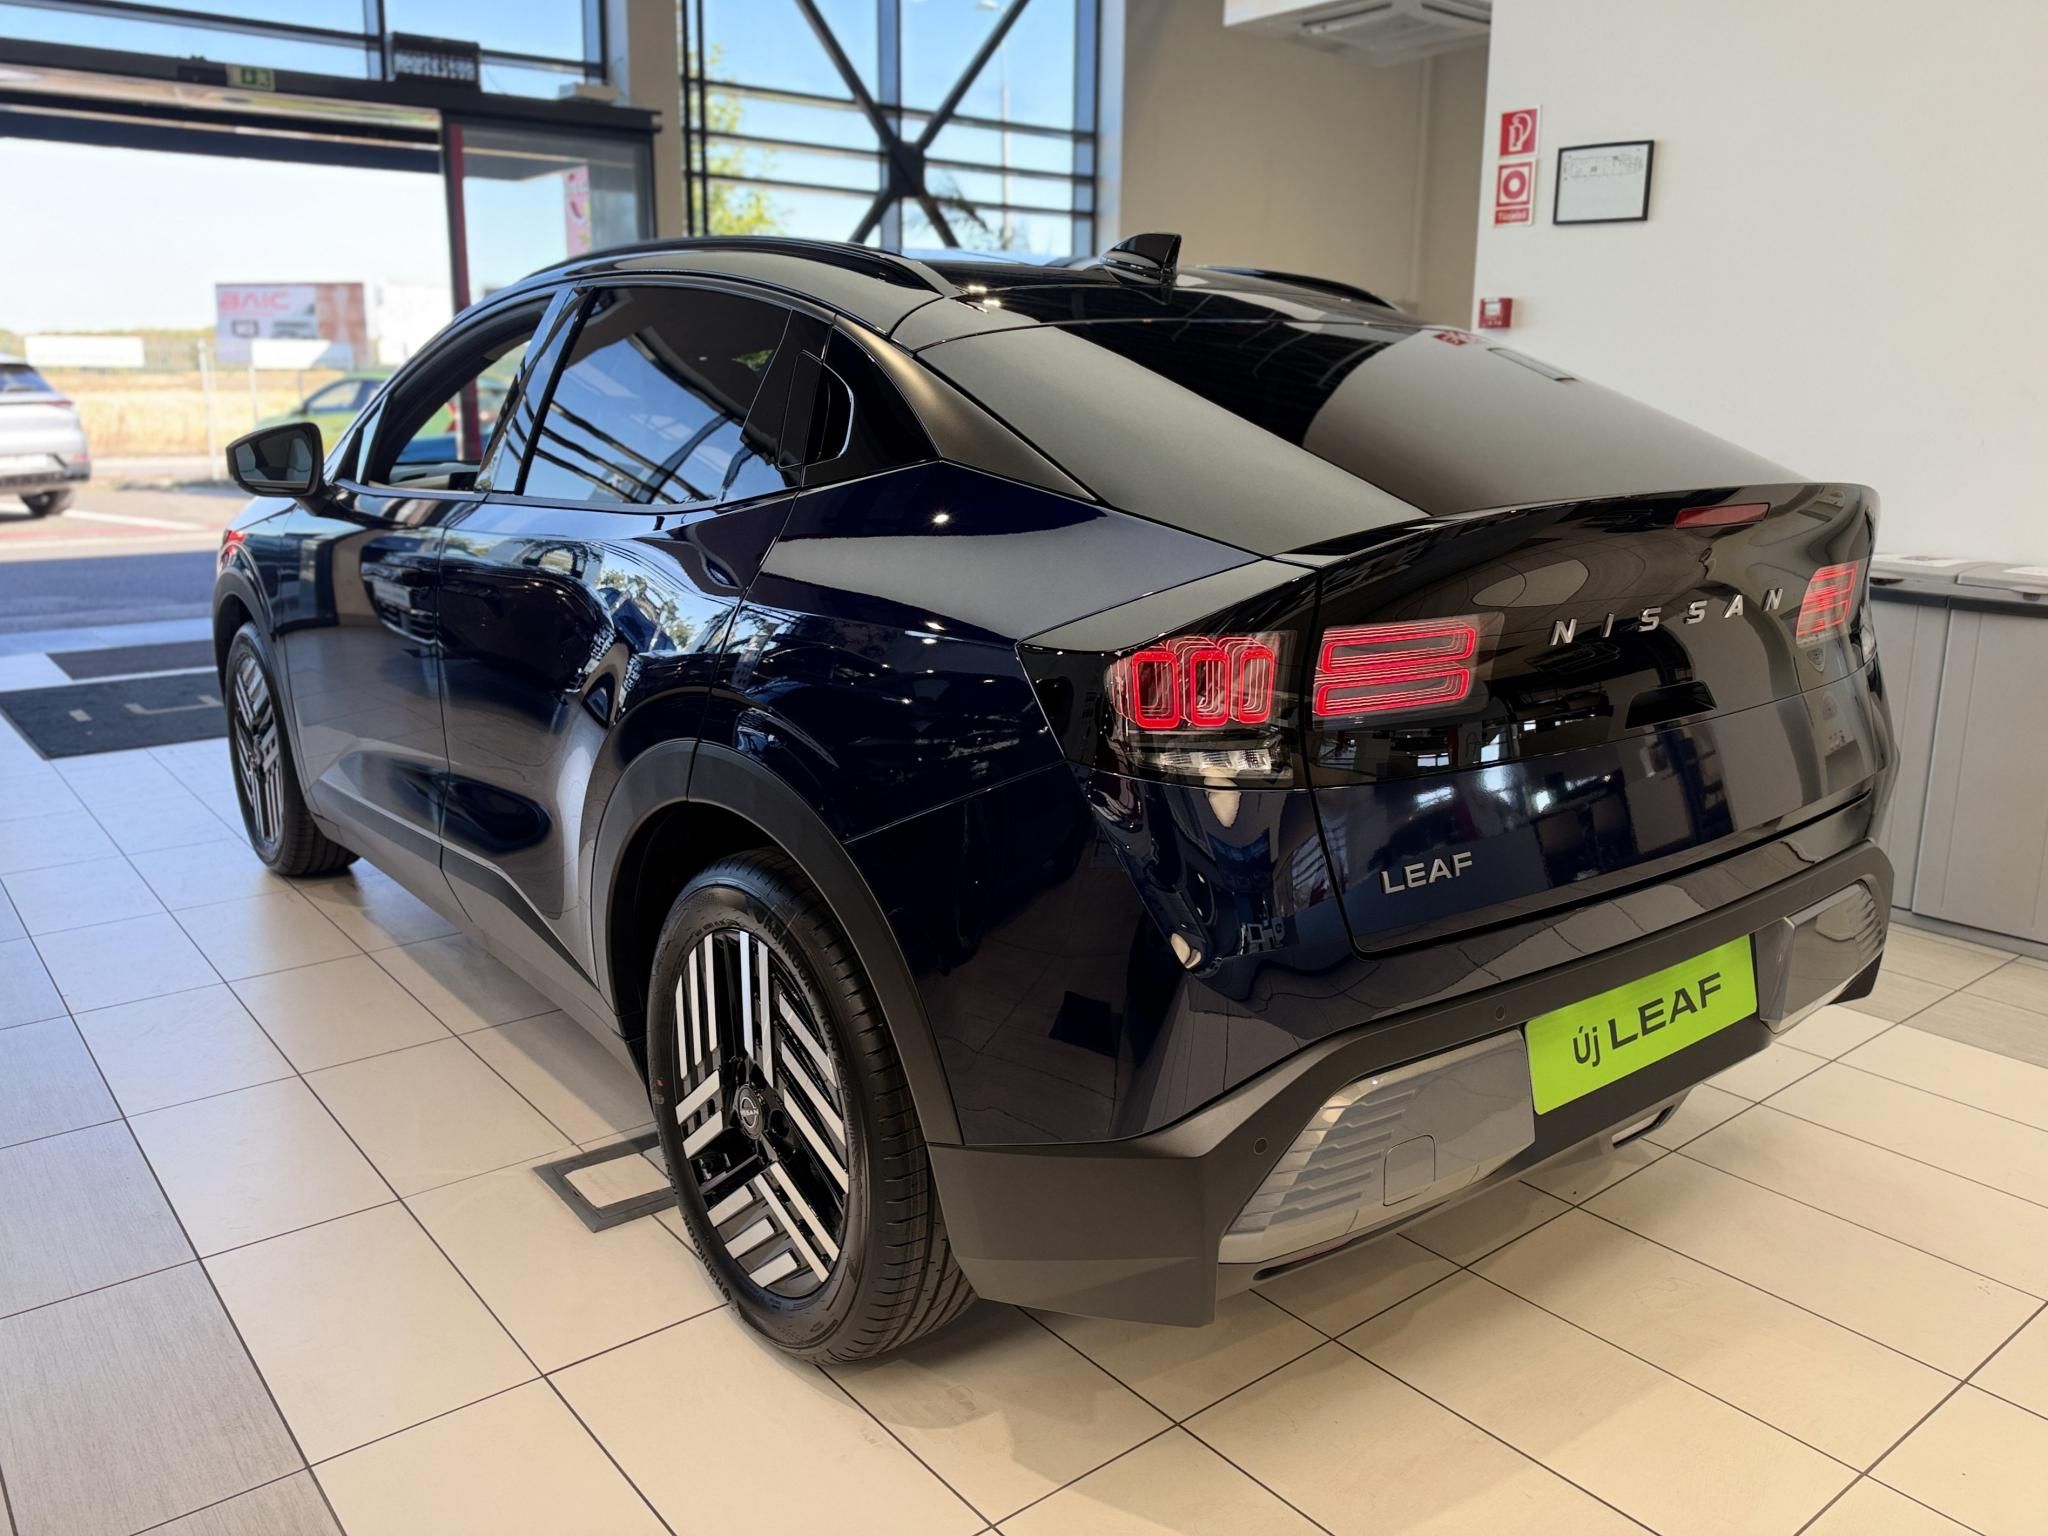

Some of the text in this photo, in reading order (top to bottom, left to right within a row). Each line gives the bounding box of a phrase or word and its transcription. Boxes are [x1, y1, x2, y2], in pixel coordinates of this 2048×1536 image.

[1550, 588, 1784, 645] NISSAN
[1380, 851, 1473, 894] LEAF
[1572, 971, 1722, 1067] Új LEAF
